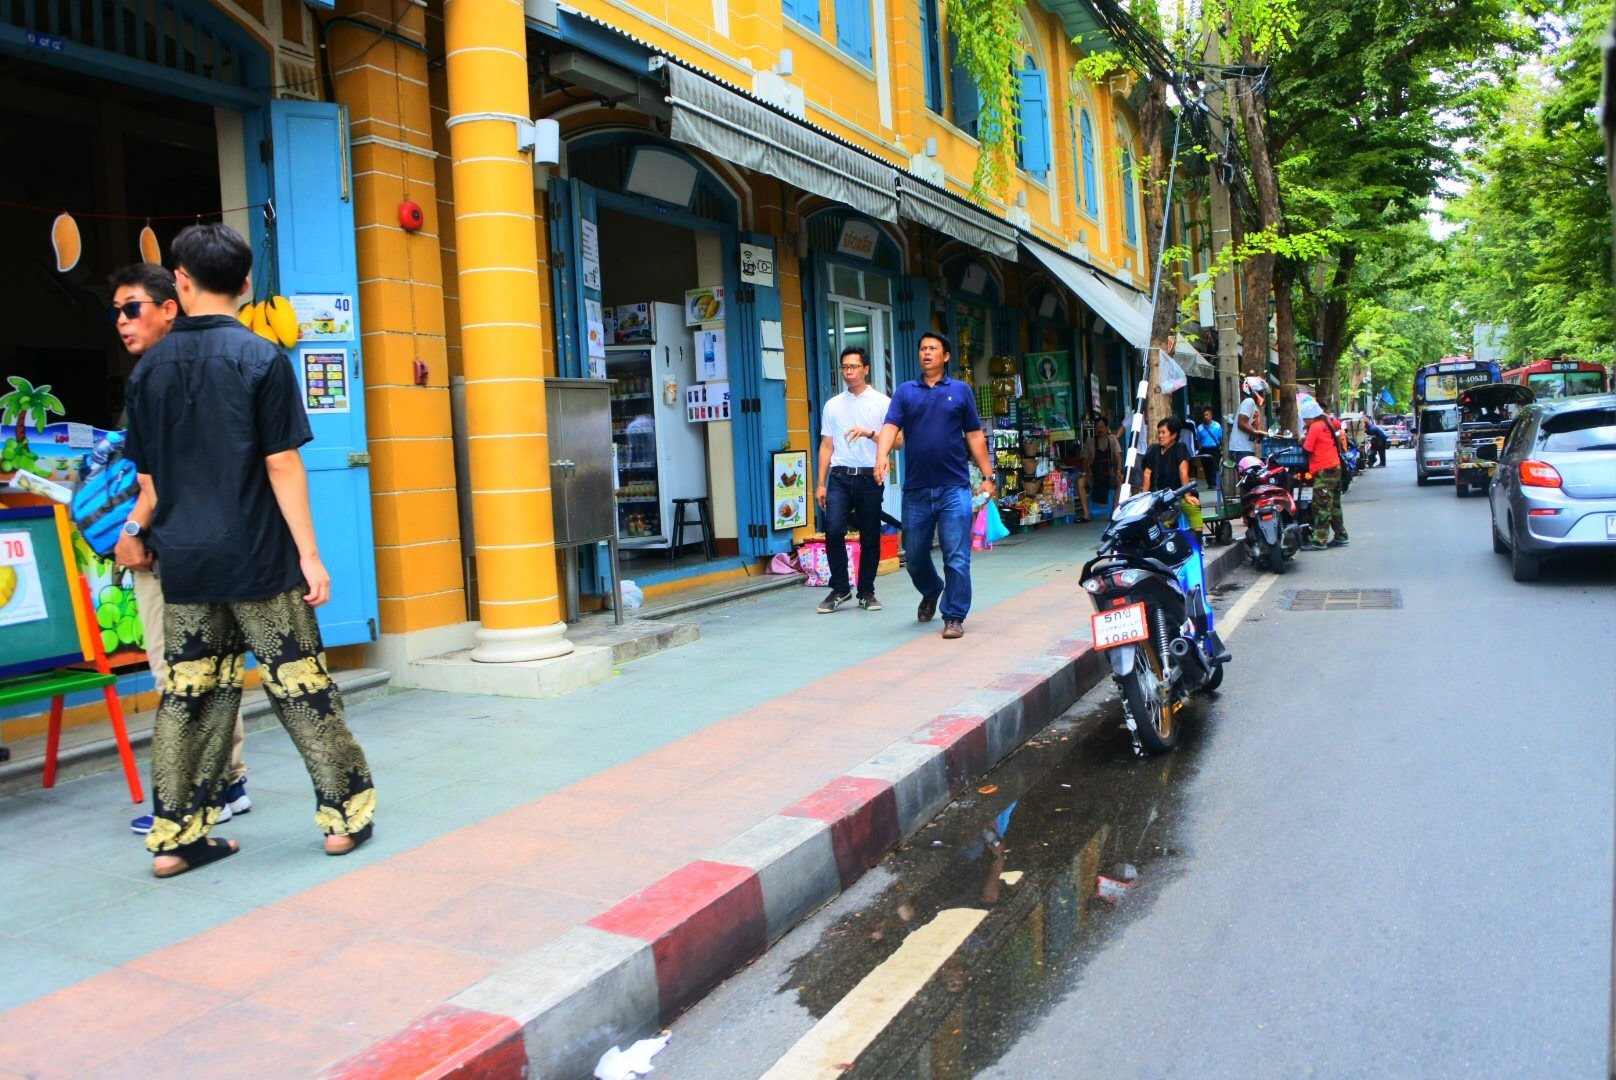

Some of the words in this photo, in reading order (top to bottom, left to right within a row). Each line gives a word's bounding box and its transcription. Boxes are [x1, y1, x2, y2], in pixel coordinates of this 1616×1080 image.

[715, 289, 725, 298] 70
[335, 299, 350, 312] 40
[637, 304, 646, 313] 40
[4, 540, 25, 559] 70
[1104, 629, 1138, 644] 1080
